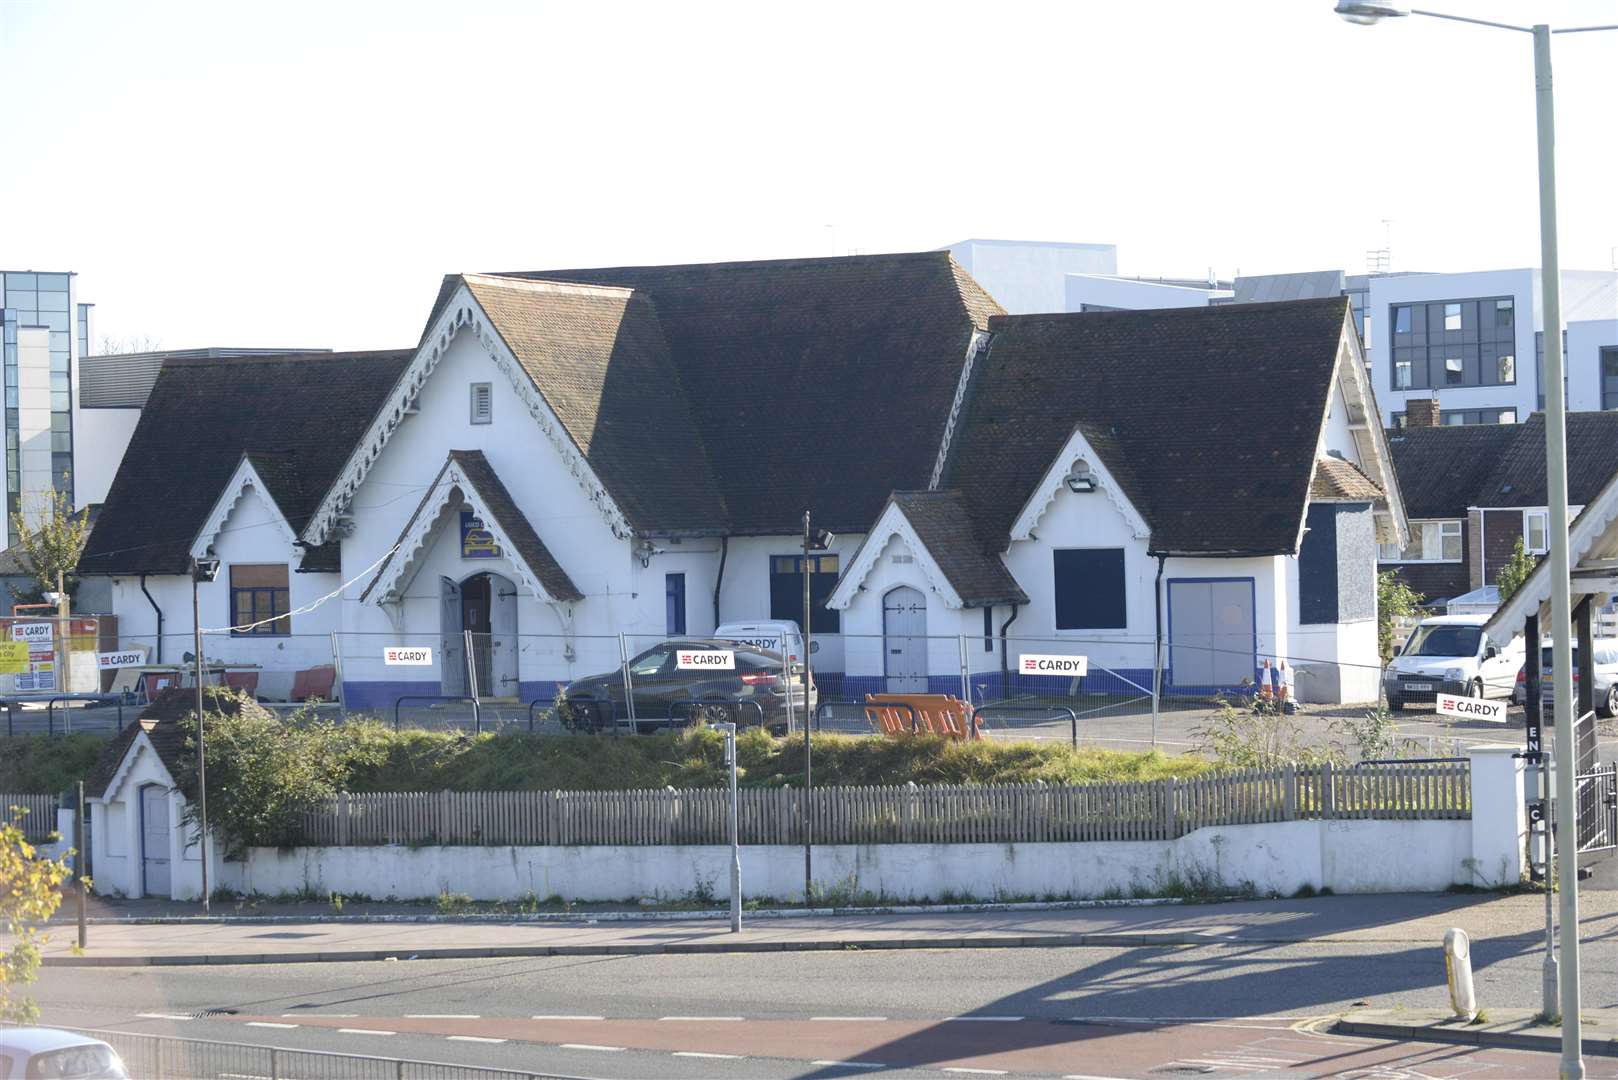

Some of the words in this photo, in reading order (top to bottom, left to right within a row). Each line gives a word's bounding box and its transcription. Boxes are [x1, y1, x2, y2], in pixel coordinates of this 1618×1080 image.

[25, 626, 49, 636] CARDY
[111, 654, 140, 664] CARDY
[397, 652, 427, 661] CARDY
[692, 655, 728, 665] CARDY
[1038, 660, 1080, 671] CARDY
[1457, 702, 1499, 716] CARDY
